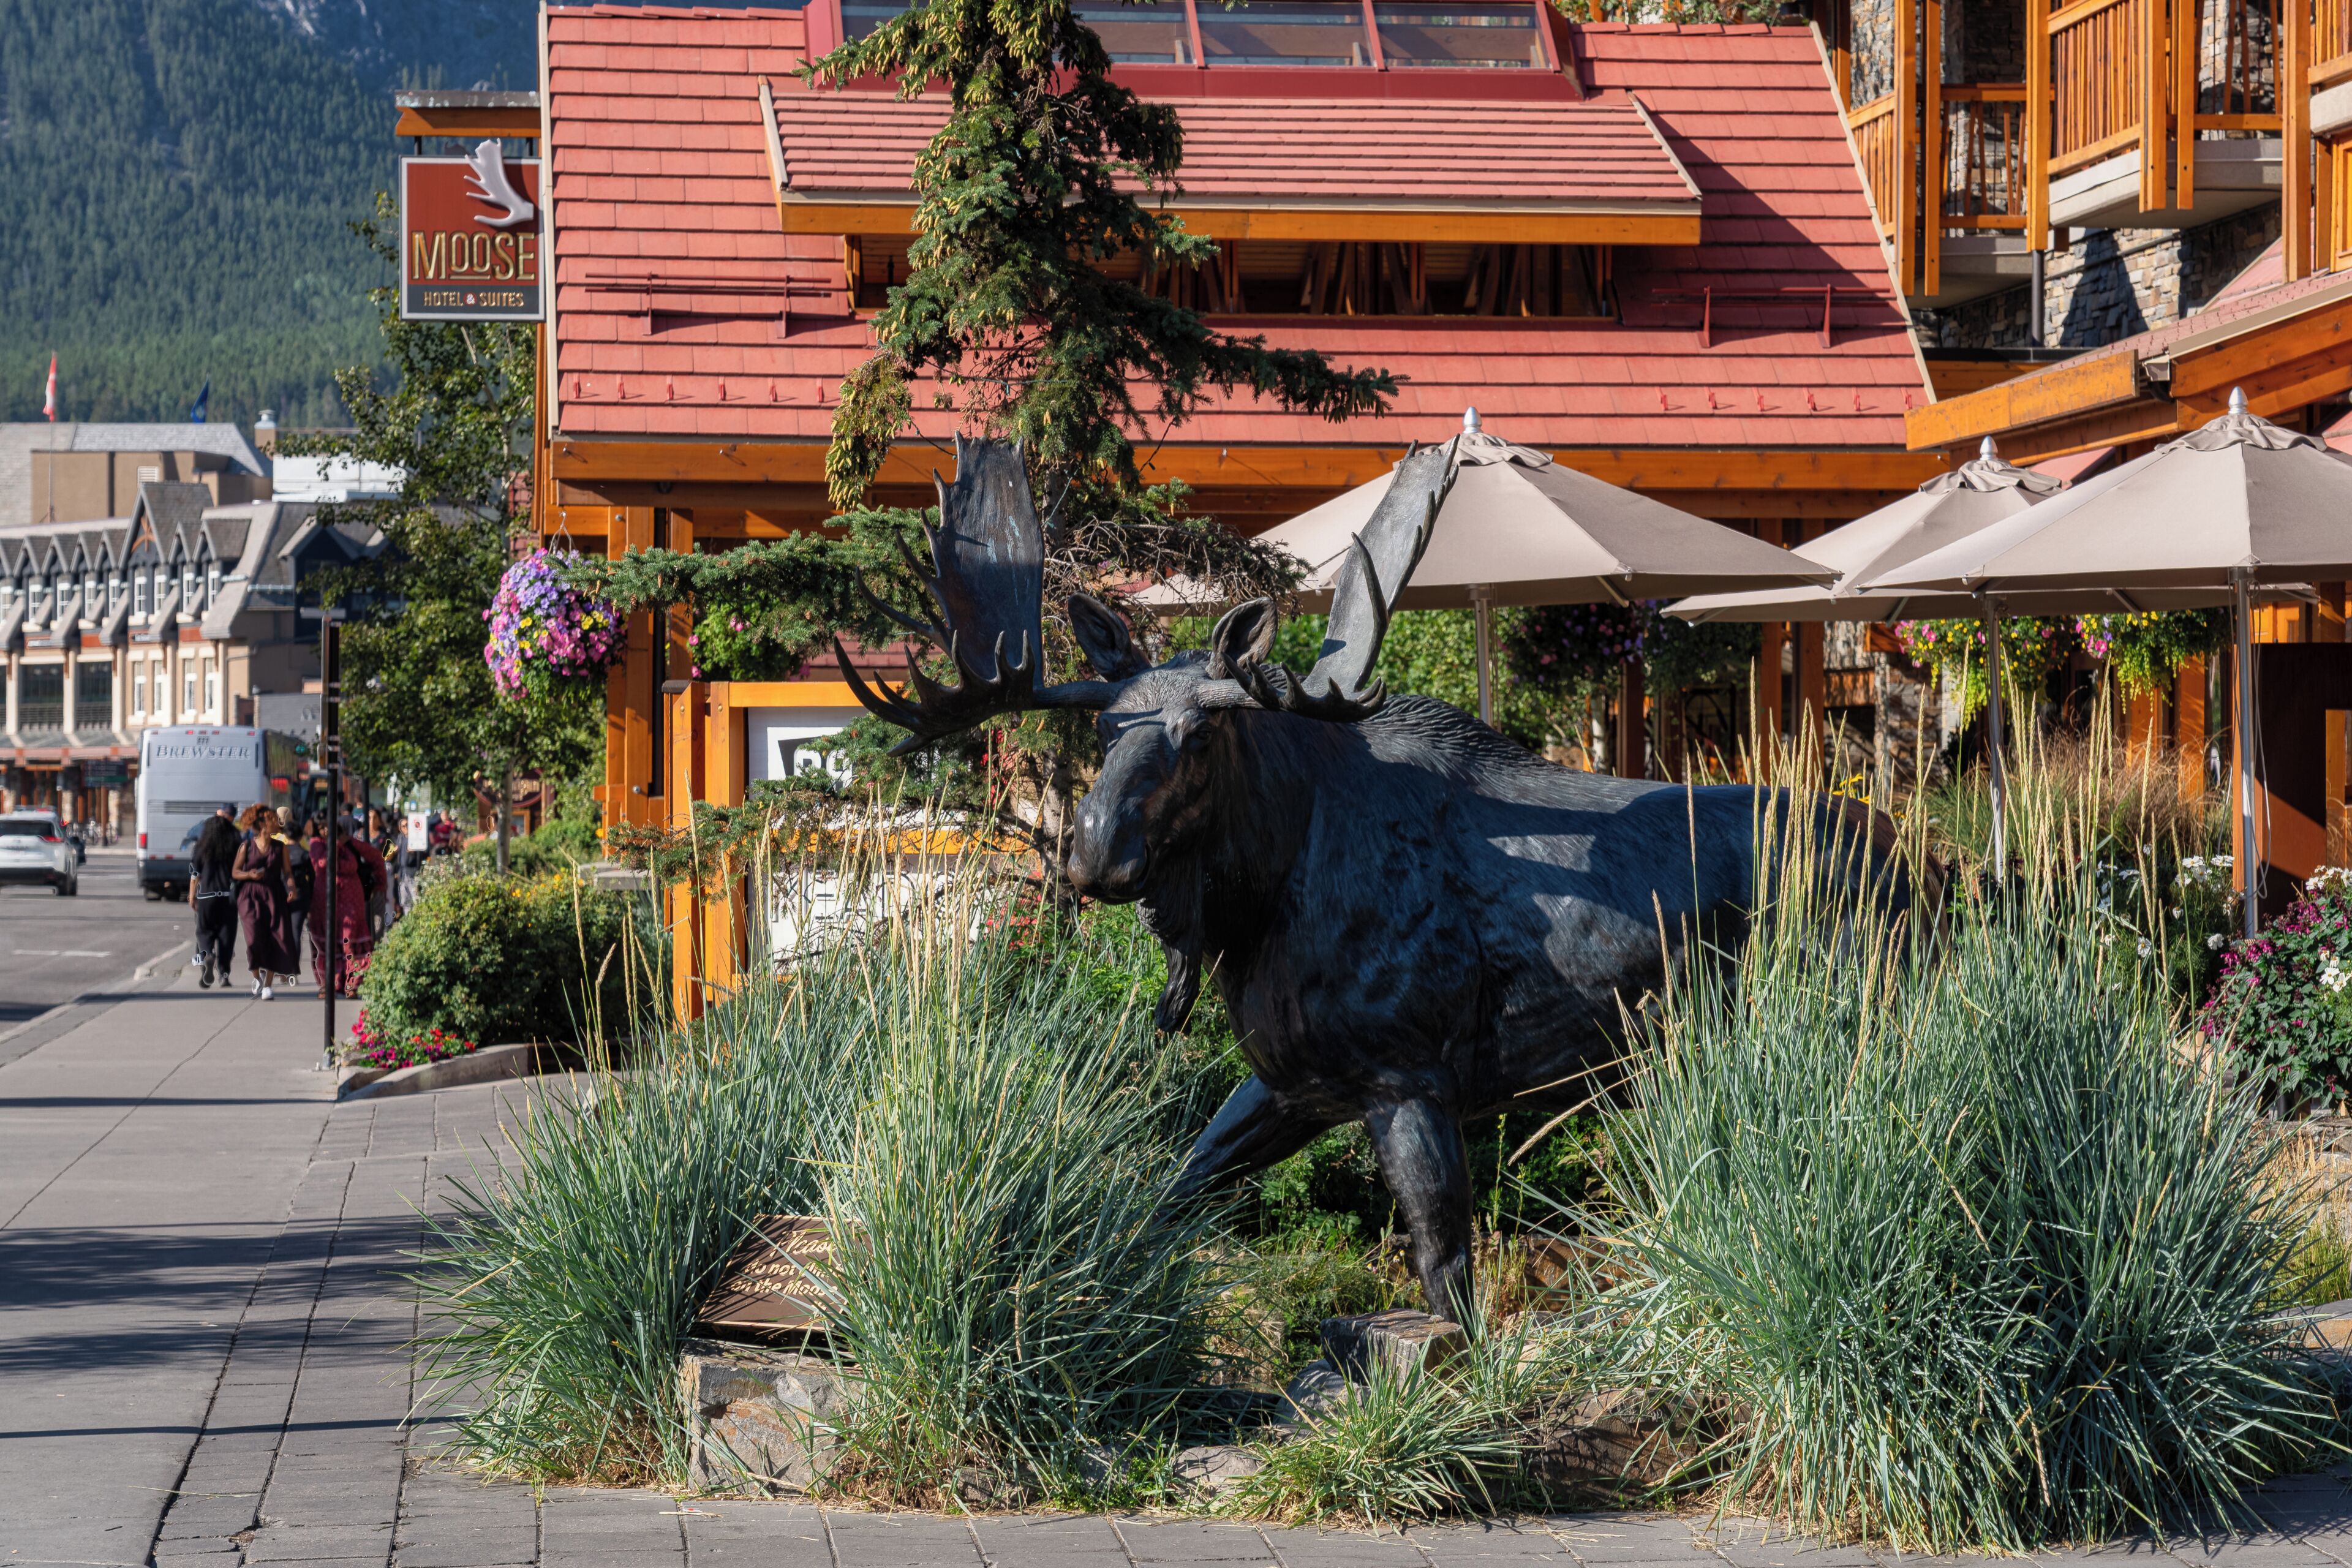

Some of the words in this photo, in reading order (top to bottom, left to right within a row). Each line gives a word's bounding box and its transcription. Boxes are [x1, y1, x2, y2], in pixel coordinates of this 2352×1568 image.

[411, 231, 535, 281] MOOSE
[423, 291, 464, 307] HOTEL
[466, 293, 476, 305] &
[480, 291, 524, 307] SUITES
[157, 745, 250, 760] BREWSTER
[753, 1278, 782, 1294] the
